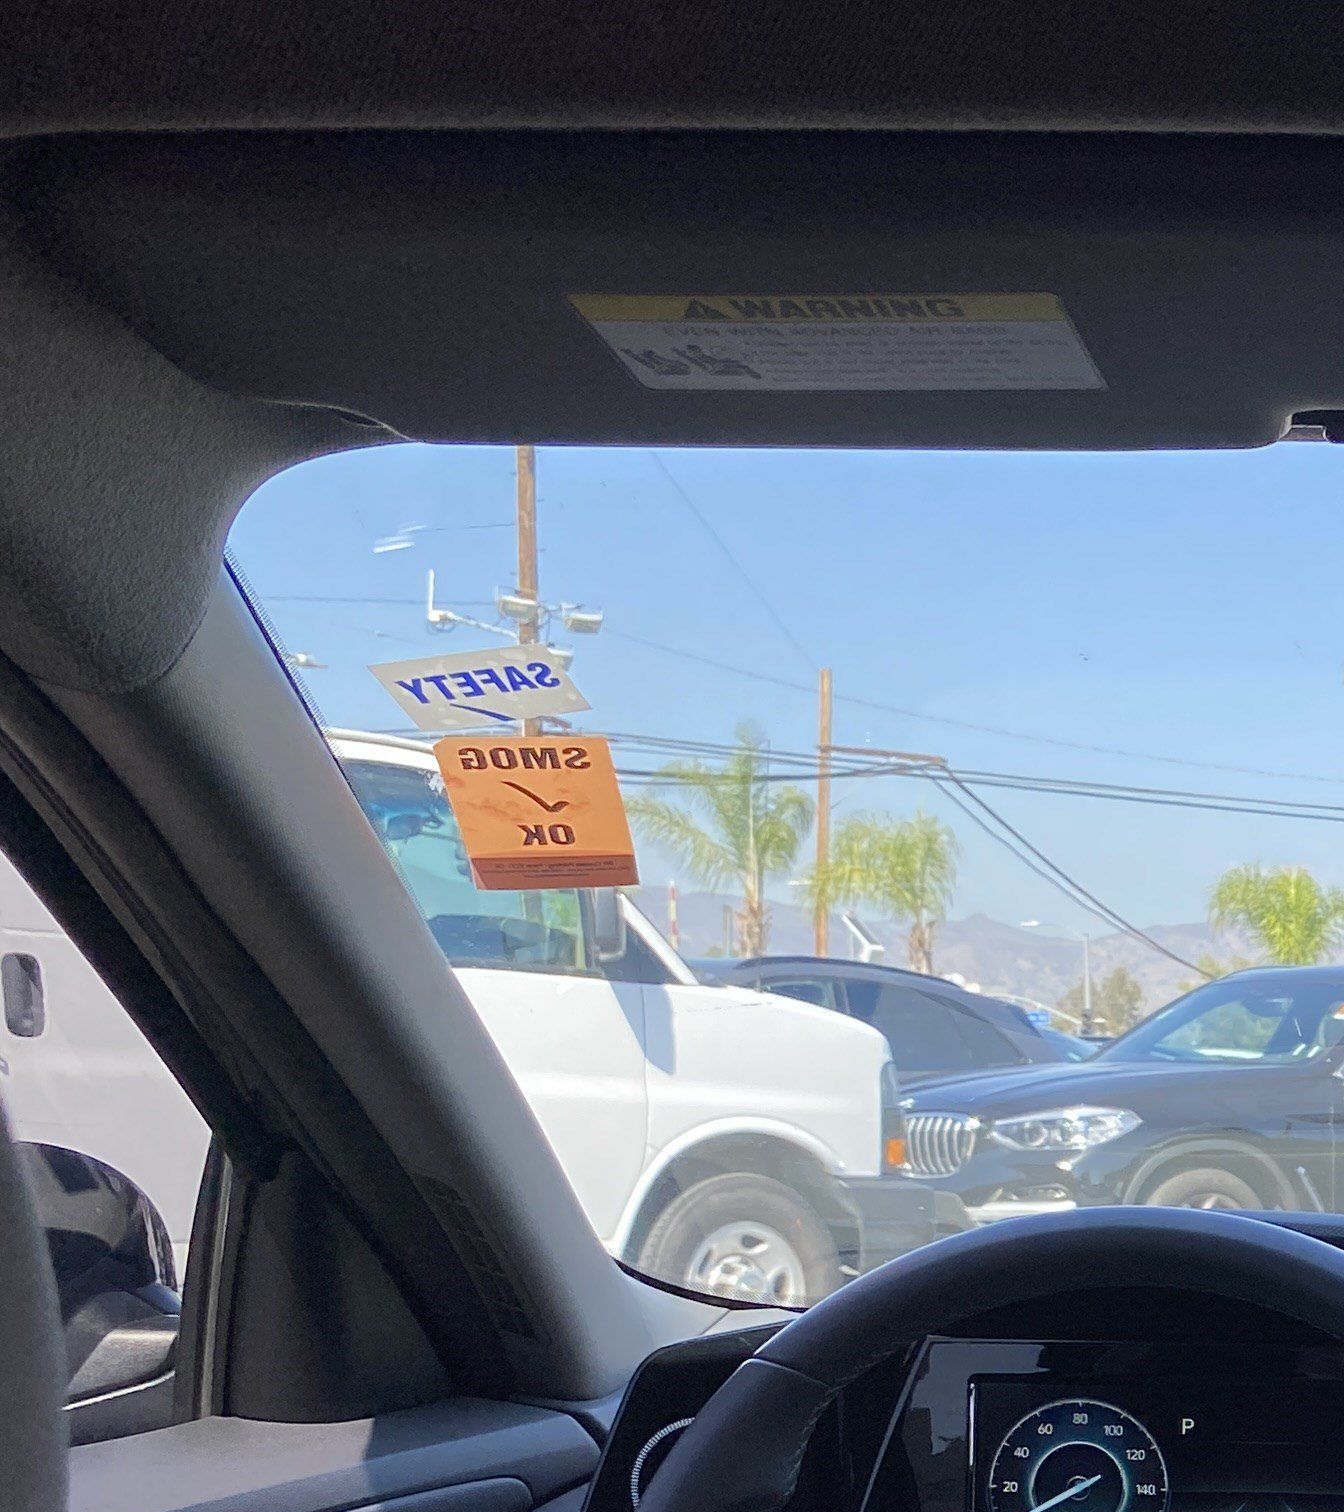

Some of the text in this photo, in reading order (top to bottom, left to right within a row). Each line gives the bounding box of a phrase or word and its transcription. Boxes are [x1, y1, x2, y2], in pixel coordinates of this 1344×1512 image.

[729, 299, 966, 319] WARNING
[1072, 1413, 1089, 1425] 80
[1038, 1423, 1053, 1435] 60
[1104, 1425, 1124, 1436] 100
[1182, 1419, 1195, 1435] P
[1014, 1447, 1029, 1458] 40
[1126, 1450, 1145, 1460] 120
[1003, 1481, 1018, 1493] 20
[1136, 1484, 1155, 1495] 140
